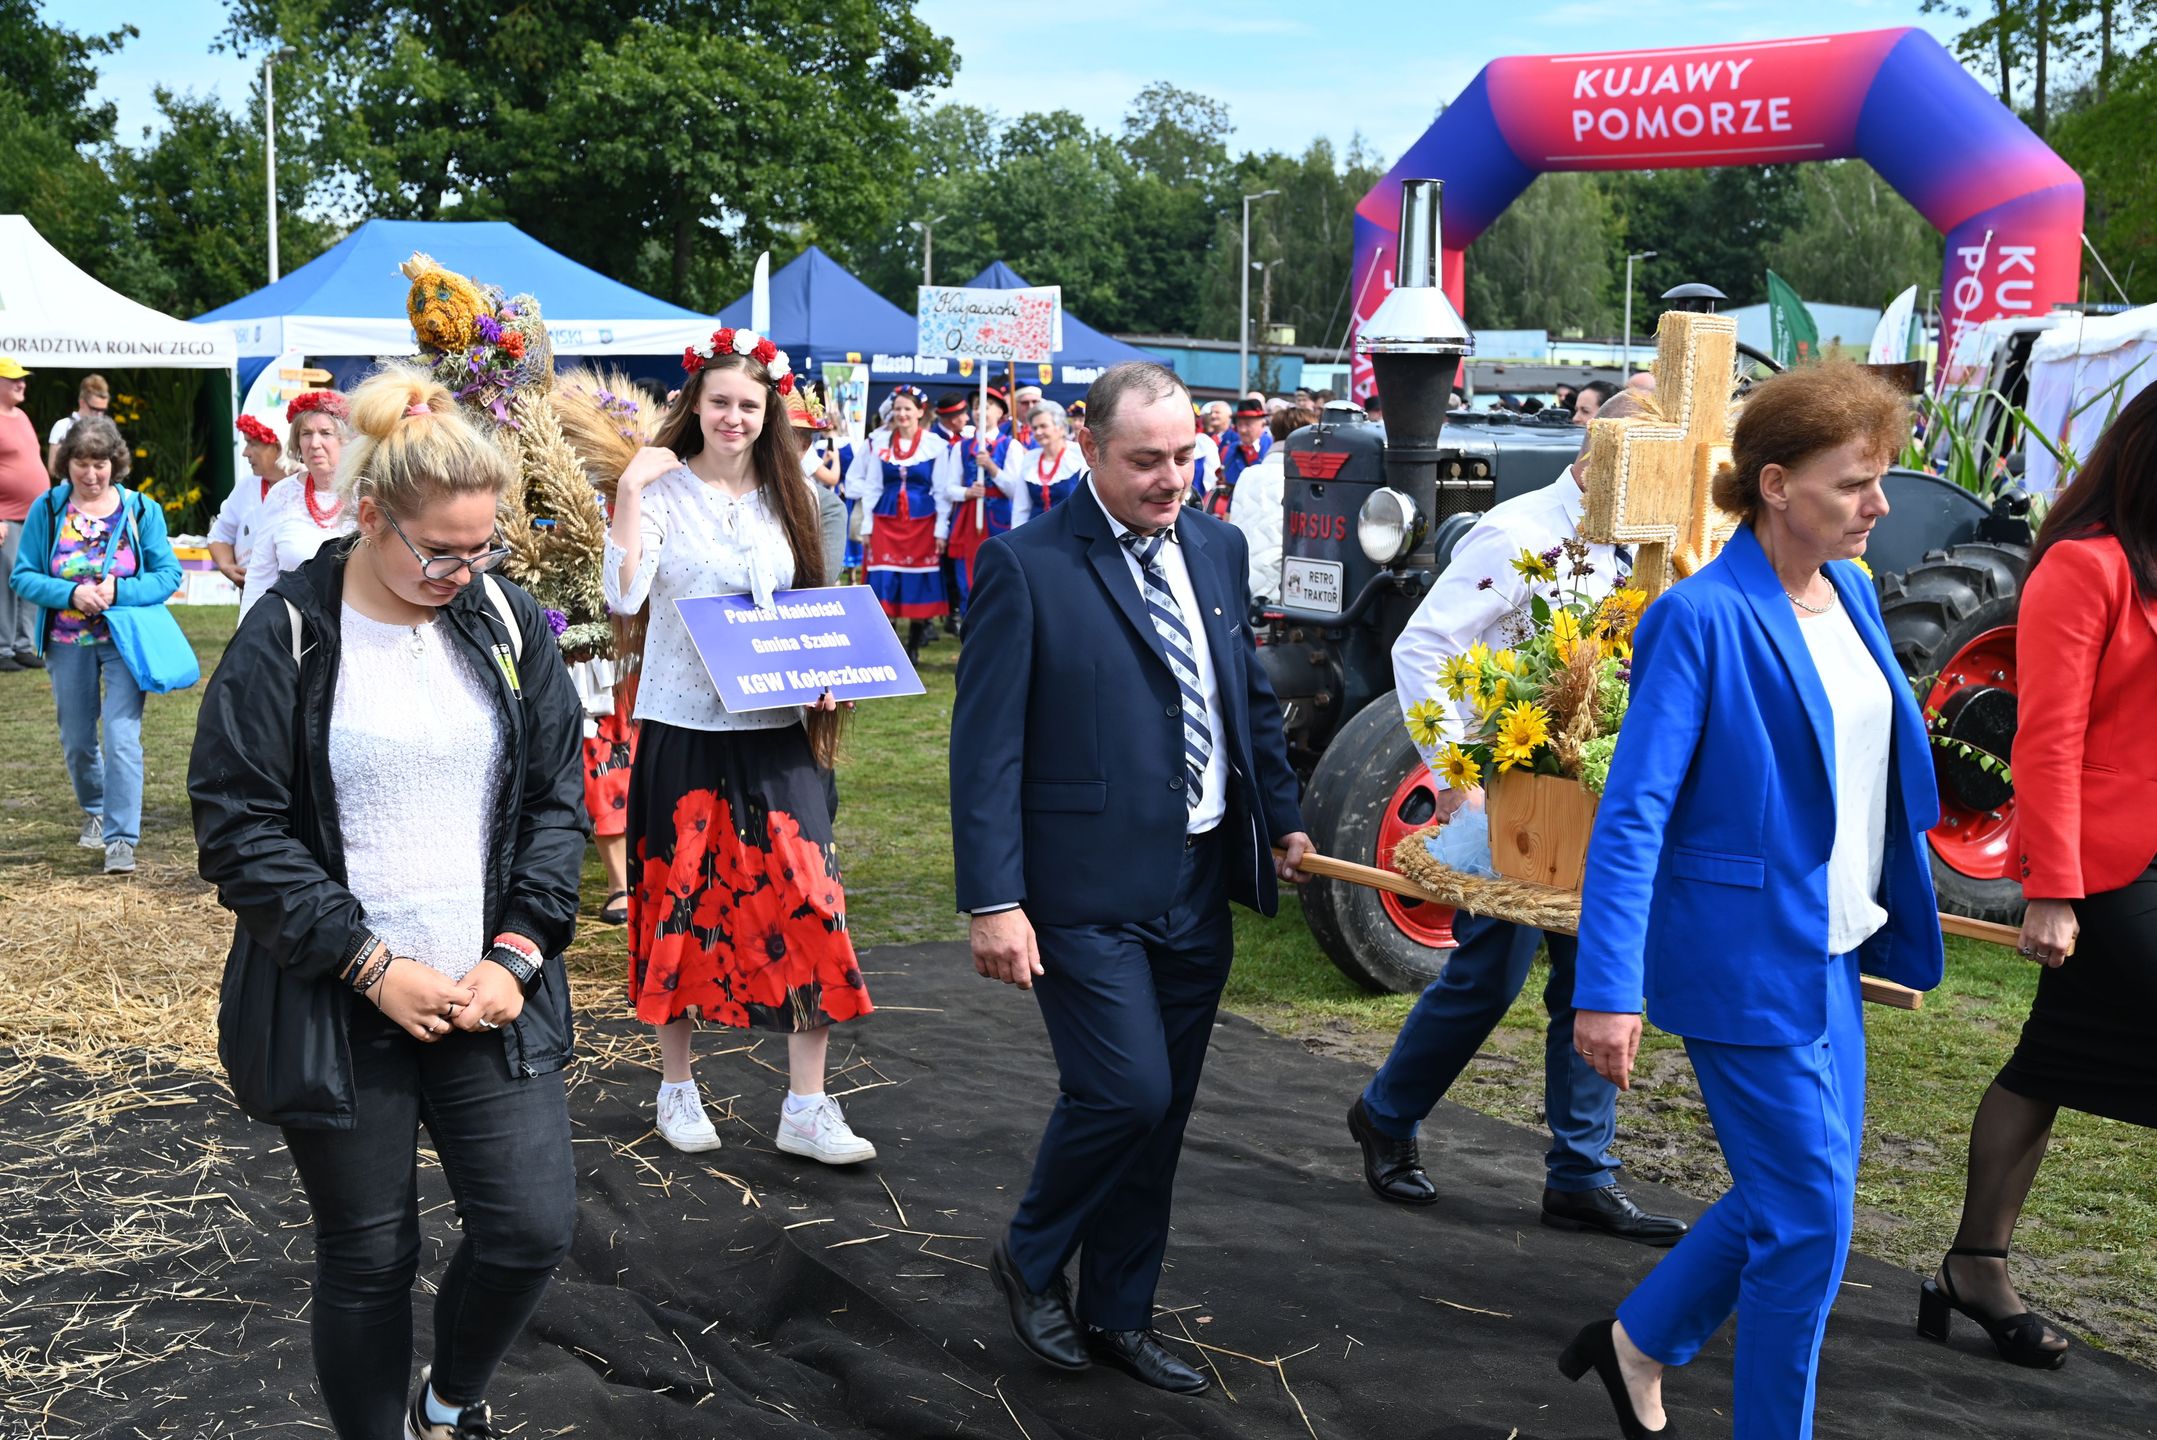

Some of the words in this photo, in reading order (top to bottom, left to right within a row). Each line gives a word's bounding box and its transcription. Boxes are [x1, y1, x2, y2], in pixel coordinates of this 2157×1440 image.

[1573, 58, 1754, 99] KUJAWY
[1572, 97, 1792, 142] POMORZE
[0, 337, 101, 353] ORADZTWA
[107, 341, 214, 356] ROLNICZEGO
[1289, 511, 1347, 541] URSUS
[1309, 570, 1334, 585] RETRO
[1303, 588, 1338, 604] TRAKTOR
[777, 600, 846, 621] Nakielski
[751, 636, 801, 654] Gmina
[799, 631, 851, 650] Szubin
[736, 671, 786, 695] KGW
[785, 664, 898, 690] Kołaczkowo
